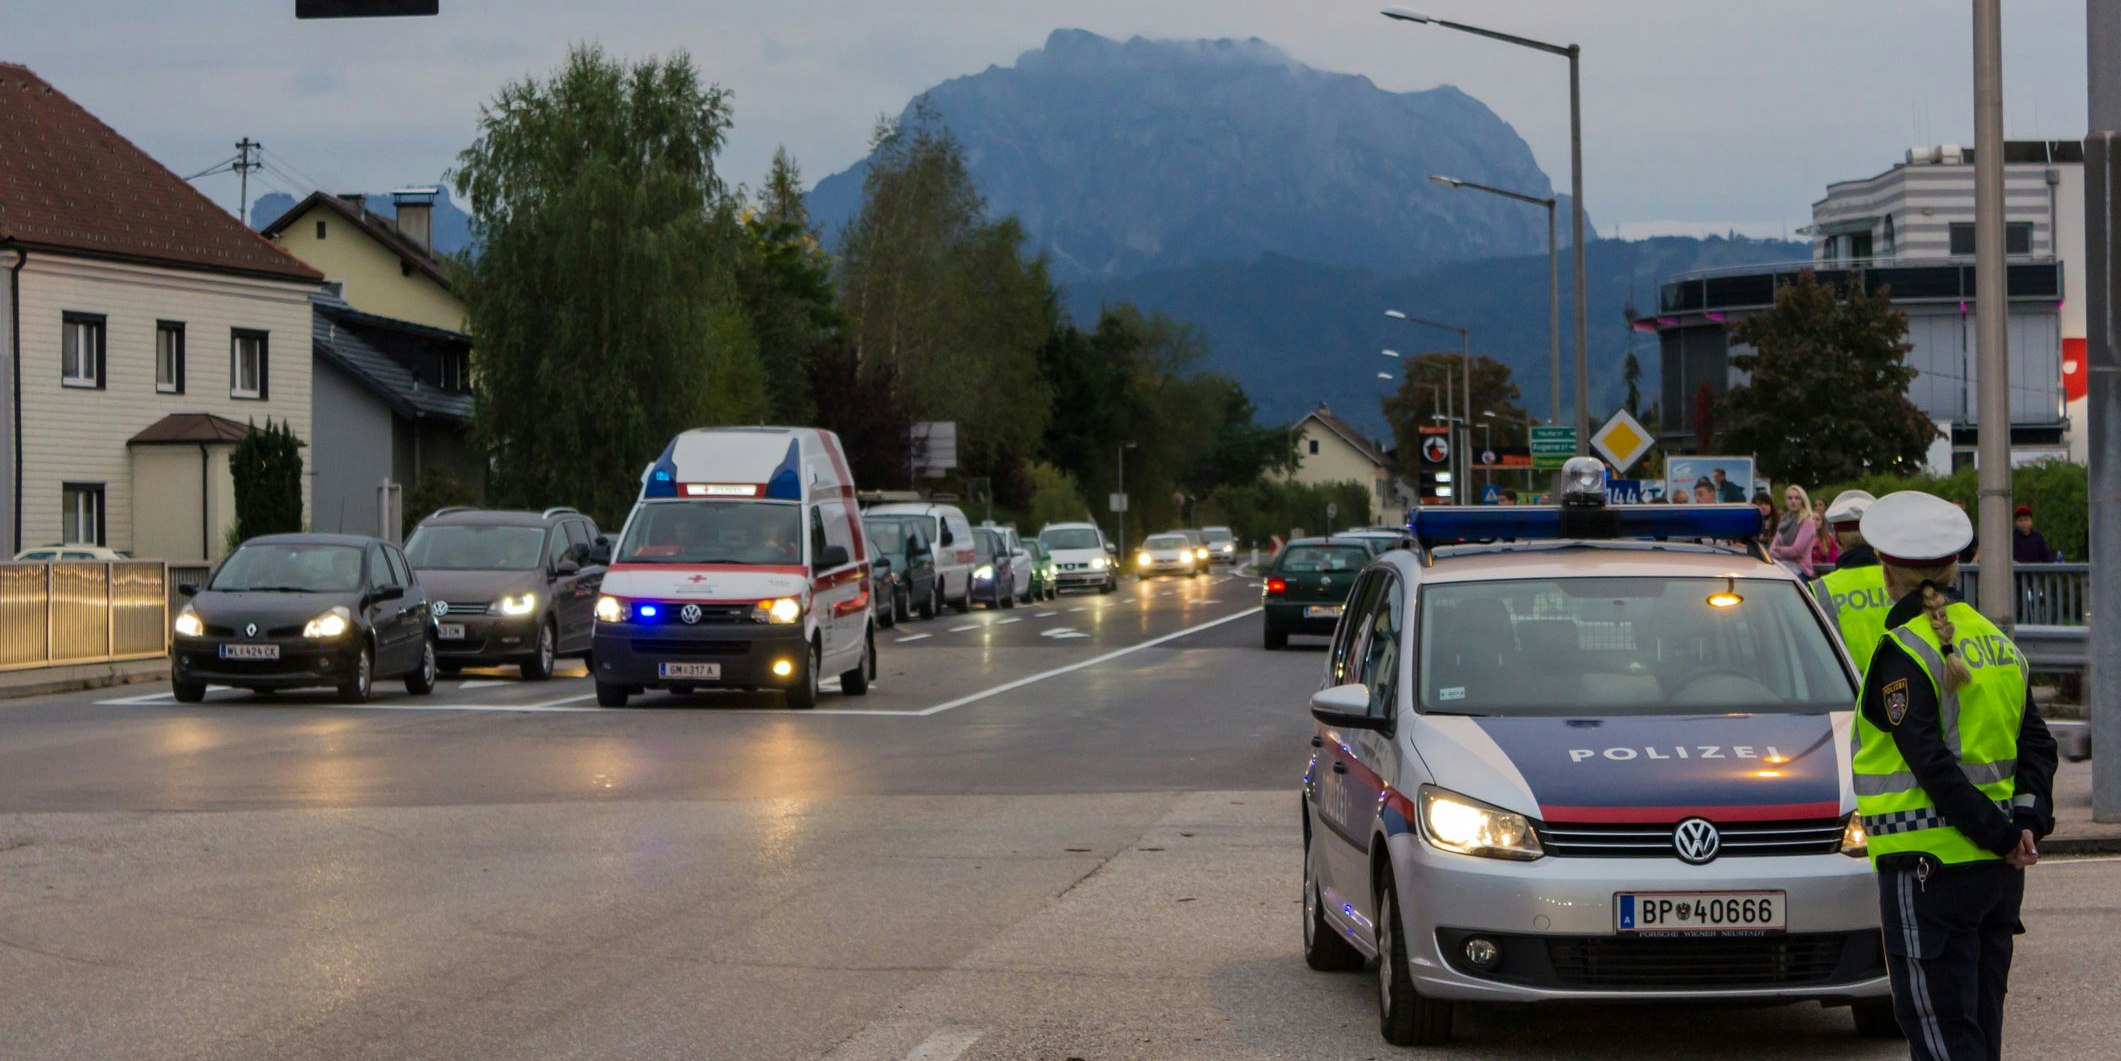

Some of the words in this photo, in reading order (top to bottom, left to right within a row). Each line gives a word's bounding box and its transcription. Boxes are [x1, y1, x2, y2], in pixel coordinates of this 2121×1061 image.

[1832, 586, 1893, 614] POLI
[1953, 635, 2019, 668] OLIZ
[1568, 745, 1781, 762] POLIZEI
[1643, 900, 1673, 924] BP
[1694, 899, 1772, 924] 40666
